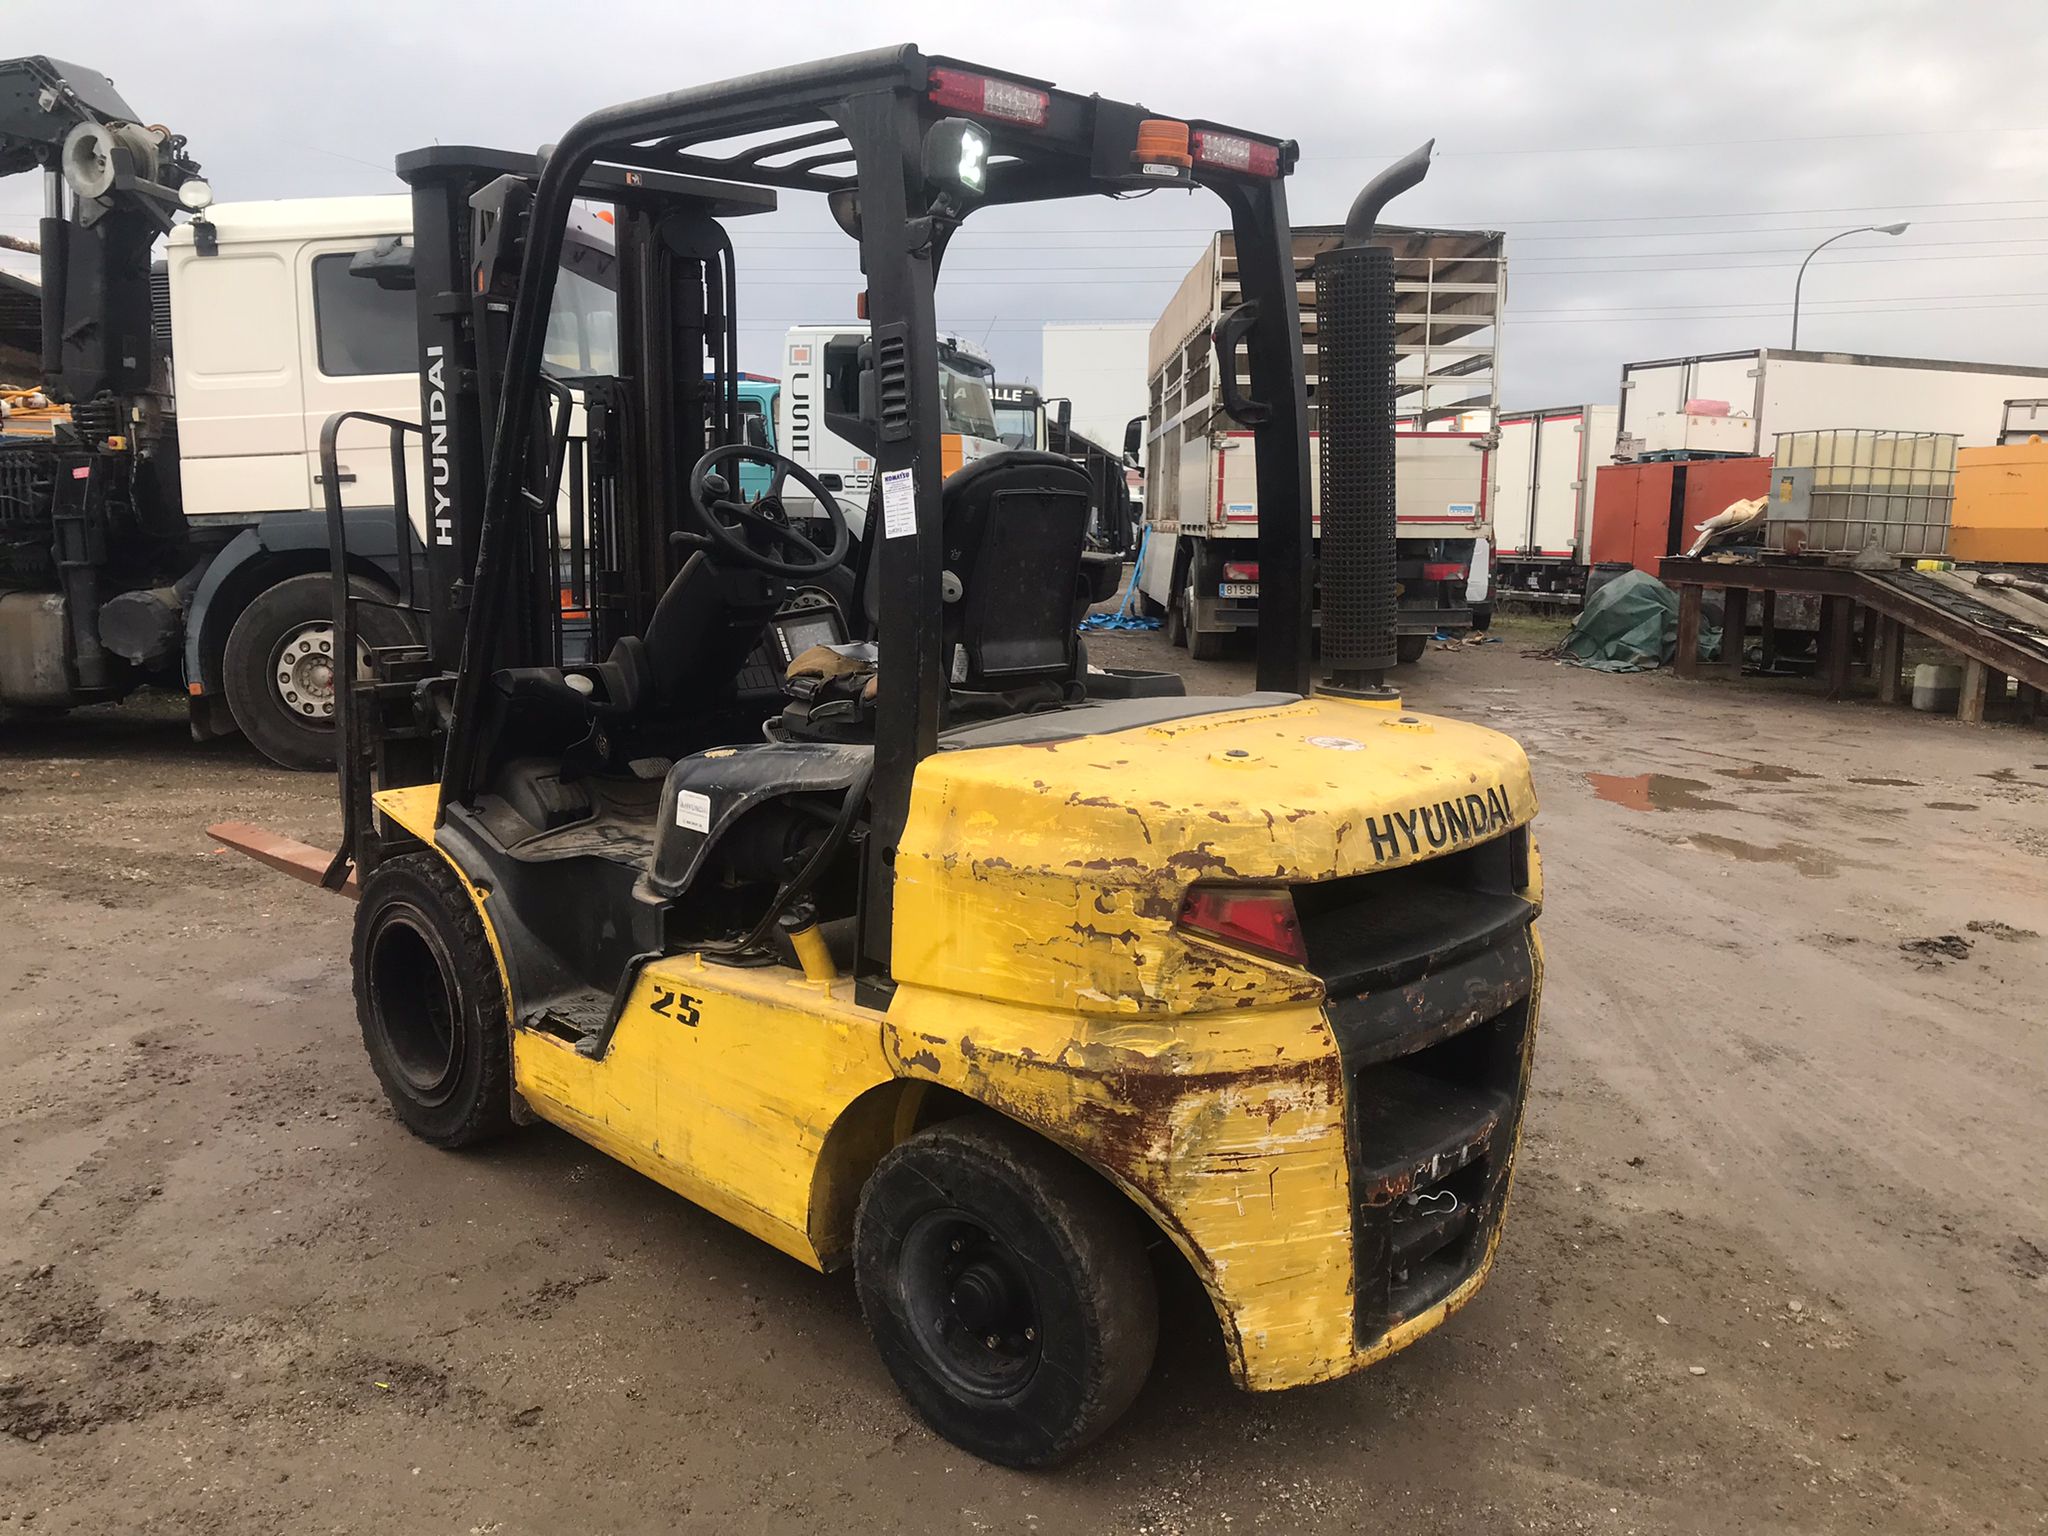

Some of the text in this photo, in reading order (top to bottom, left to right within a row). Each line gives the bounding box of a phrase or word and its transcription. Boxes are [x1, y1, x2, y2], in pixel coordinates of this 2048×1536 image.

[427, 346, 453, 546] HYUNDAI
[885, 471, 910, 482] KOMATSU
[1227, 585, 1252, 595] 8159
[1366, 784, 1514, 862] HYUNDAI
[650, 985, 703, 1027] 25
